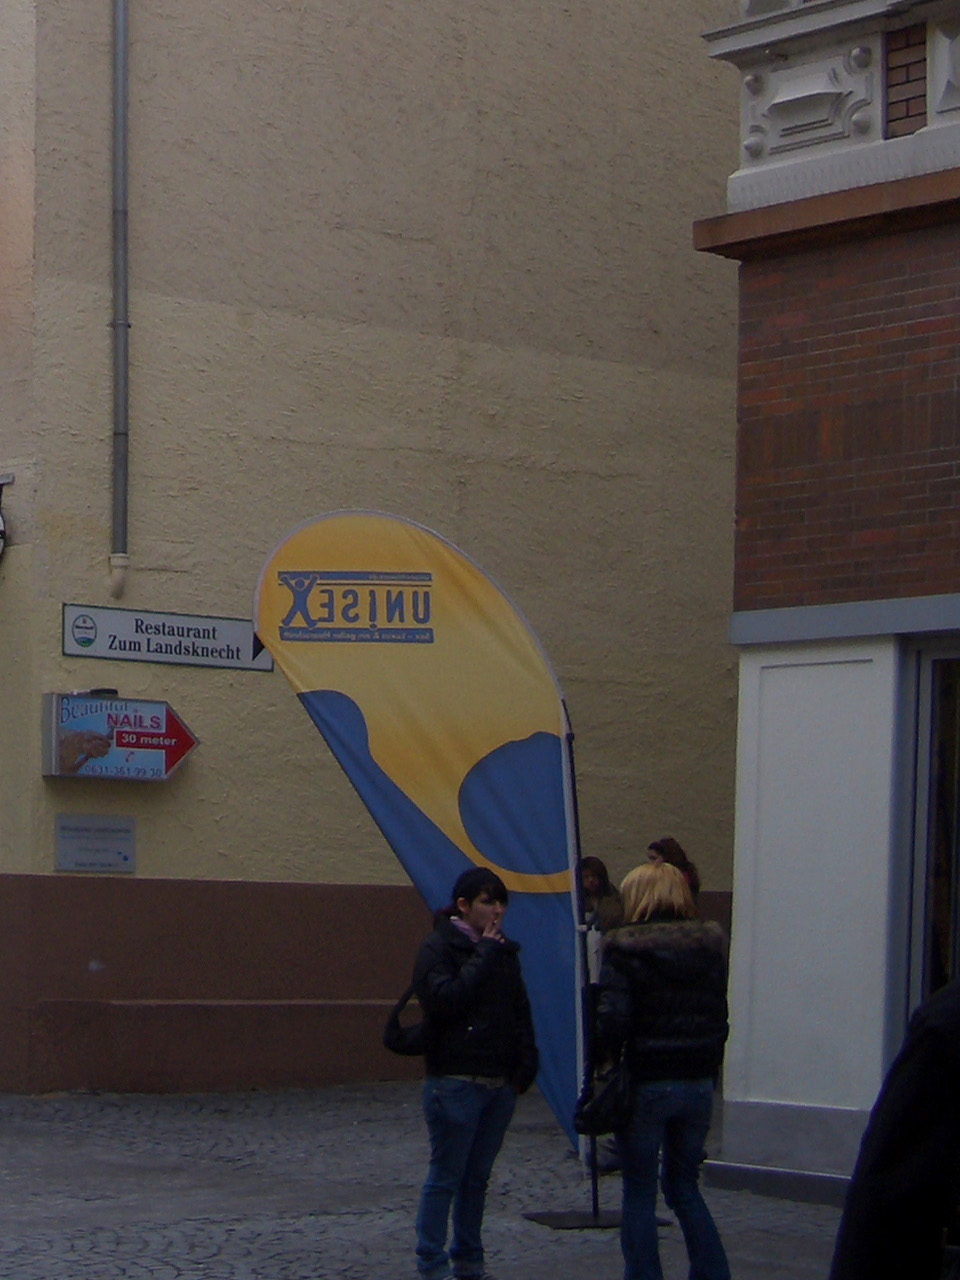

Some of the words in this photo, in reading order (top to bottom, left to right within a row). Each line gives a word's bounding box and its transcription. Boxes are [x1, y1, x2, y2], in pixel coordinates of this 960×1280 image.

[134, 618, 218, 641] Restaurant
[108, 634, 142, 652] Zum
[146, 637, 242, 660] Landsknecht
[121, 733, 137, 744] 30
[141, 734, 177, 746] meter
